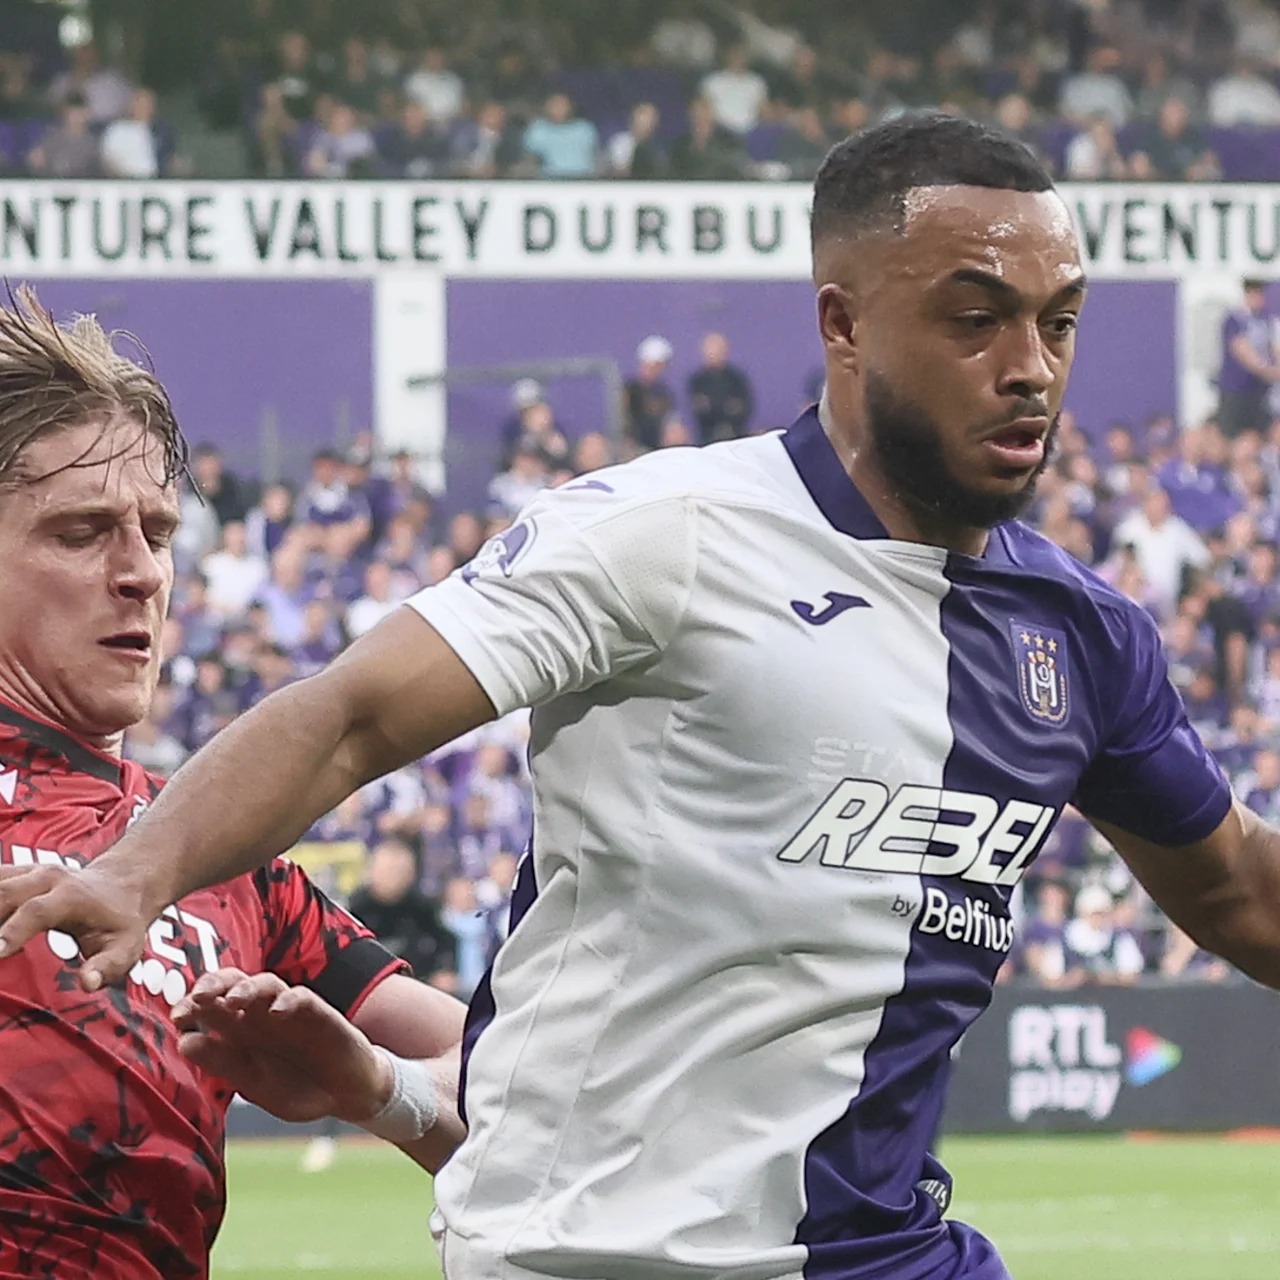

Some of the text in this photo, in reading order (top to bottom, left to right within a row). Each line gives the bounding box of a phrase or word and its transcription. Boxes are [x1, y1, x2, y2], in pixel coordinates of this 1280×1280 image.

[244, 196, 491, 263] VALLEY
[521, 203, 812, 254] DURBU
[891, 886, 1017, 953] by Belfius
[1009, 1004, 1121, 1068] RTL
[1008, 1070, 1120, 1122] play
